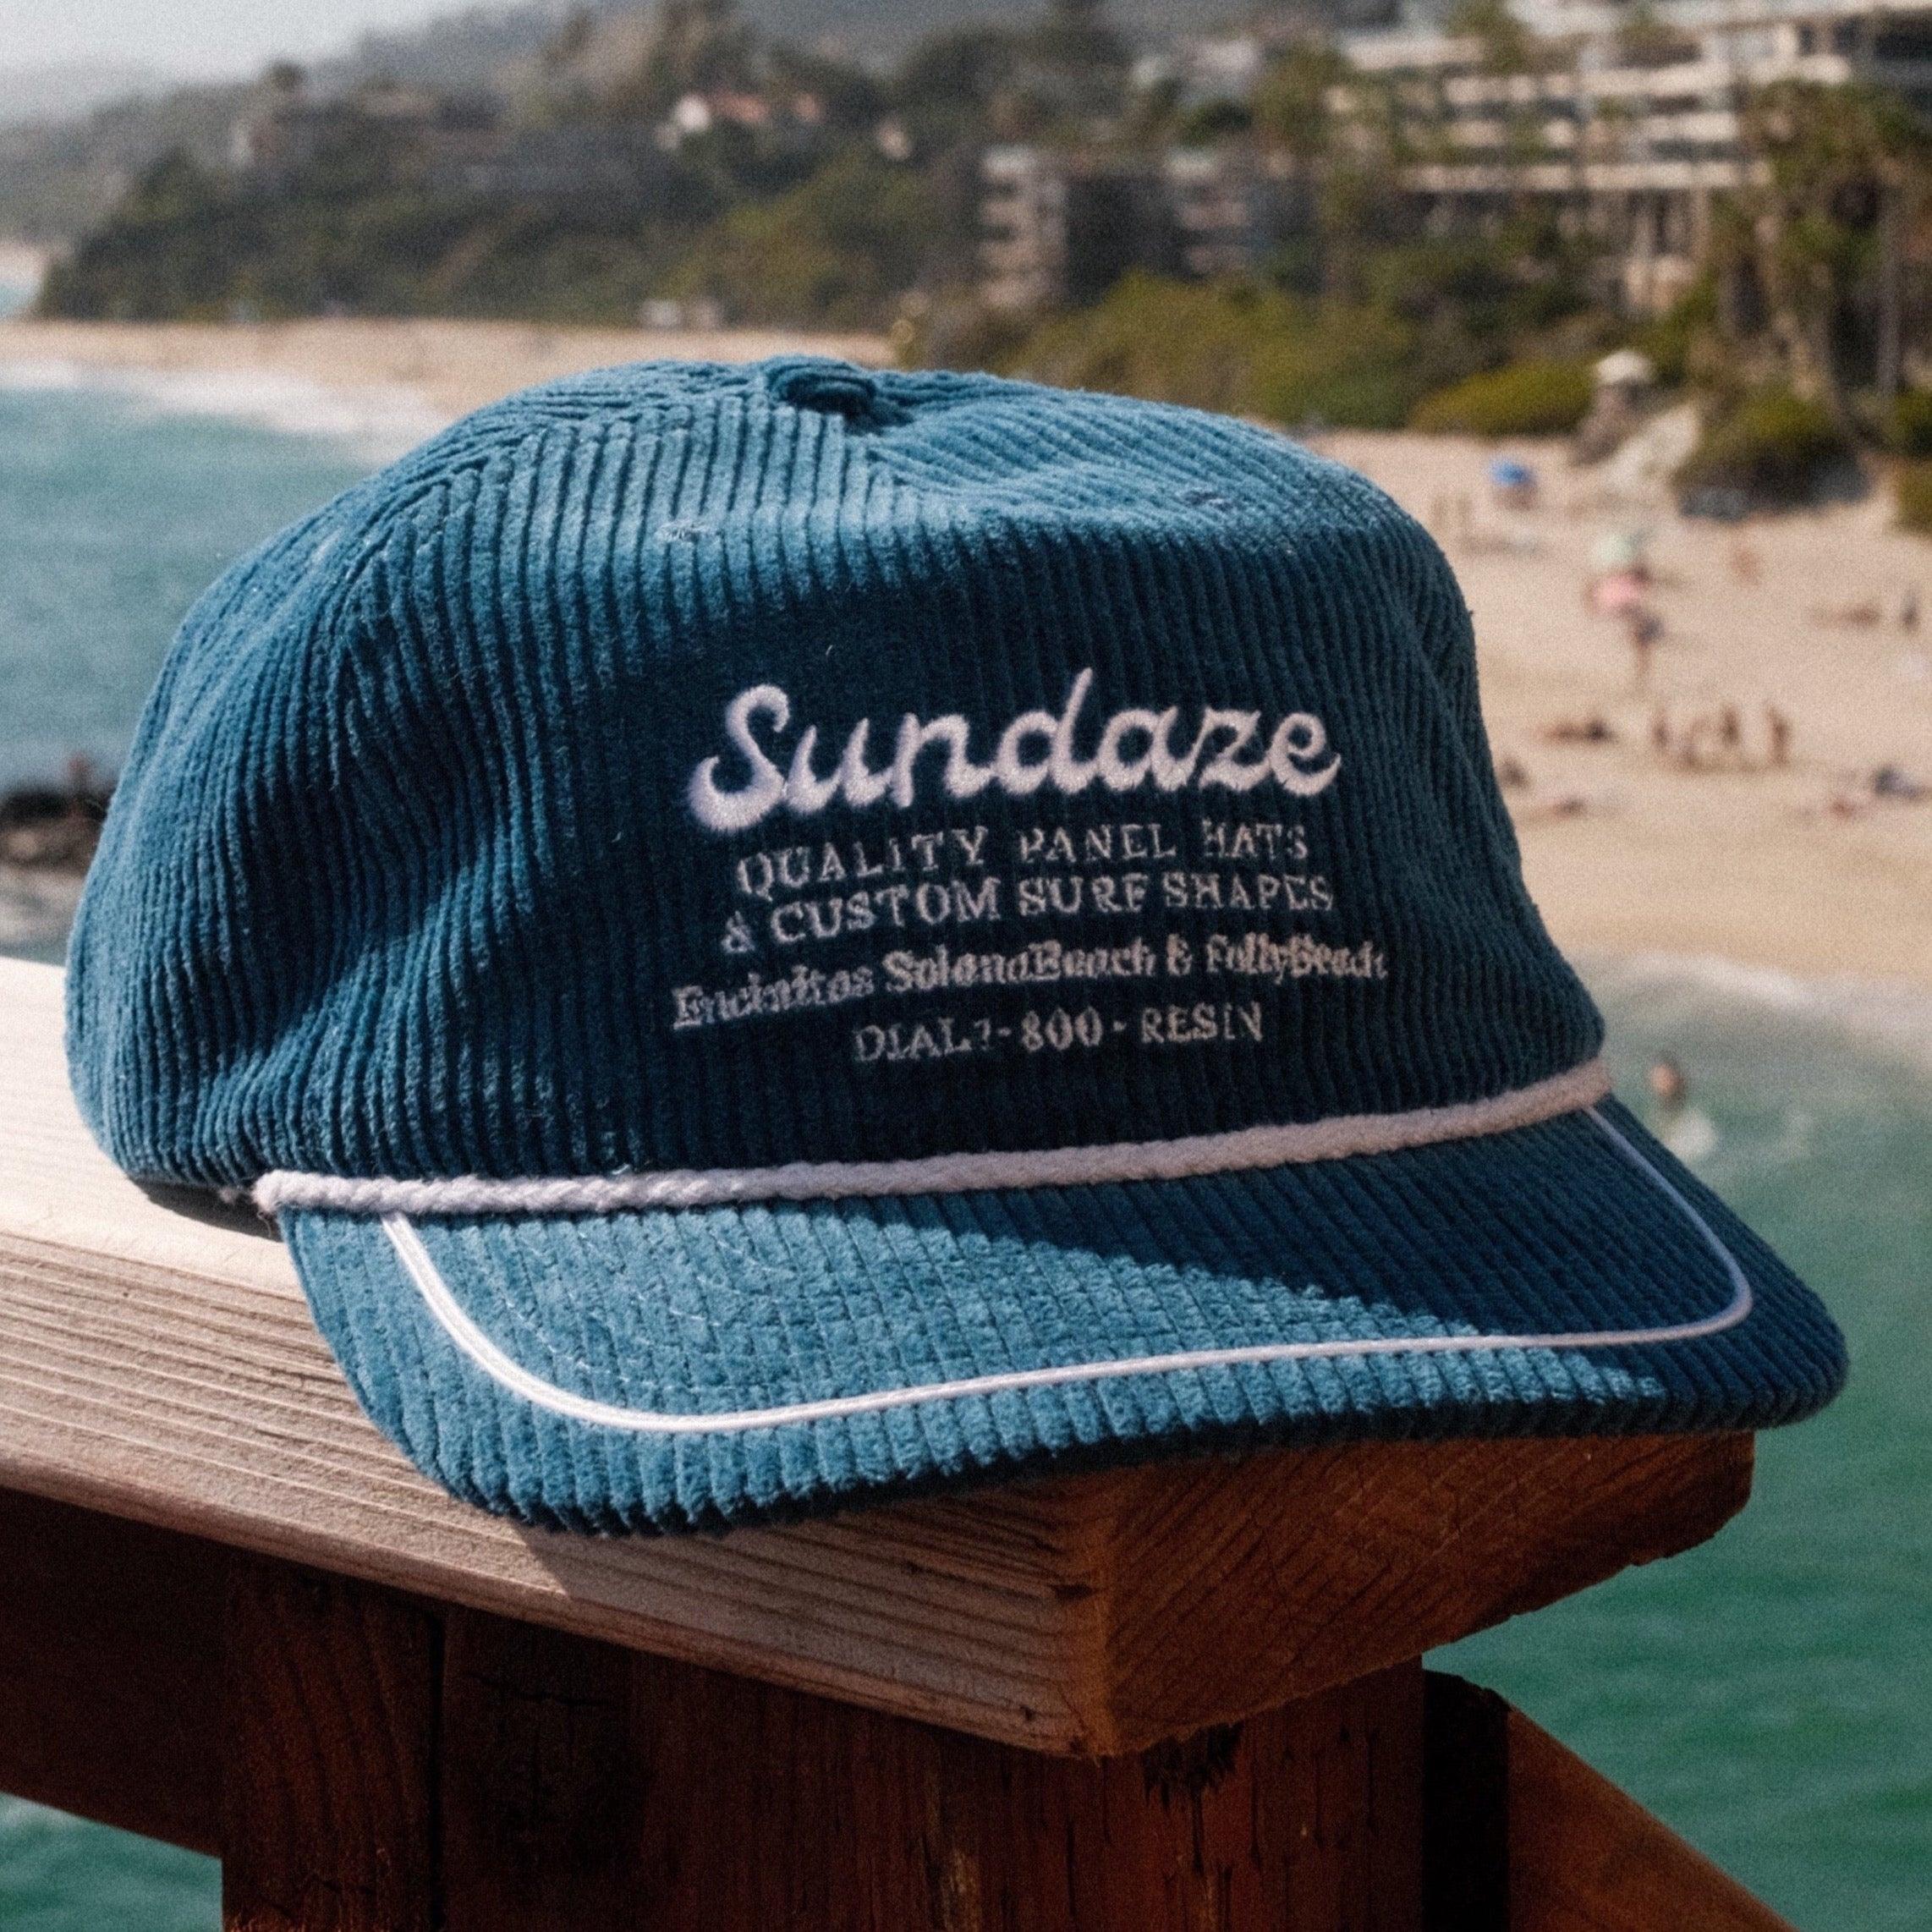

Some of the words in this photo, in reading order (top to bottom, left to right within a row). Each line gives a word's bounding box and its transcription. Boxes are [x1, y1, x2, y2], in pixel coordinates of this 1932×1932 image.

[689, 667, 1341, 832] Sundaze
[736, 826, 988, 902] QUALITY
[1018, 823, 1177, 863] PANEL
[1201, 817, 1308, 860] HATS
[721, 910, 755, 953] &
[770, 876, 1001, 944] CUSTOM
[1018, 872, 1149, 916] SURF
[1161, 870, 1333, 911] SHAPES
